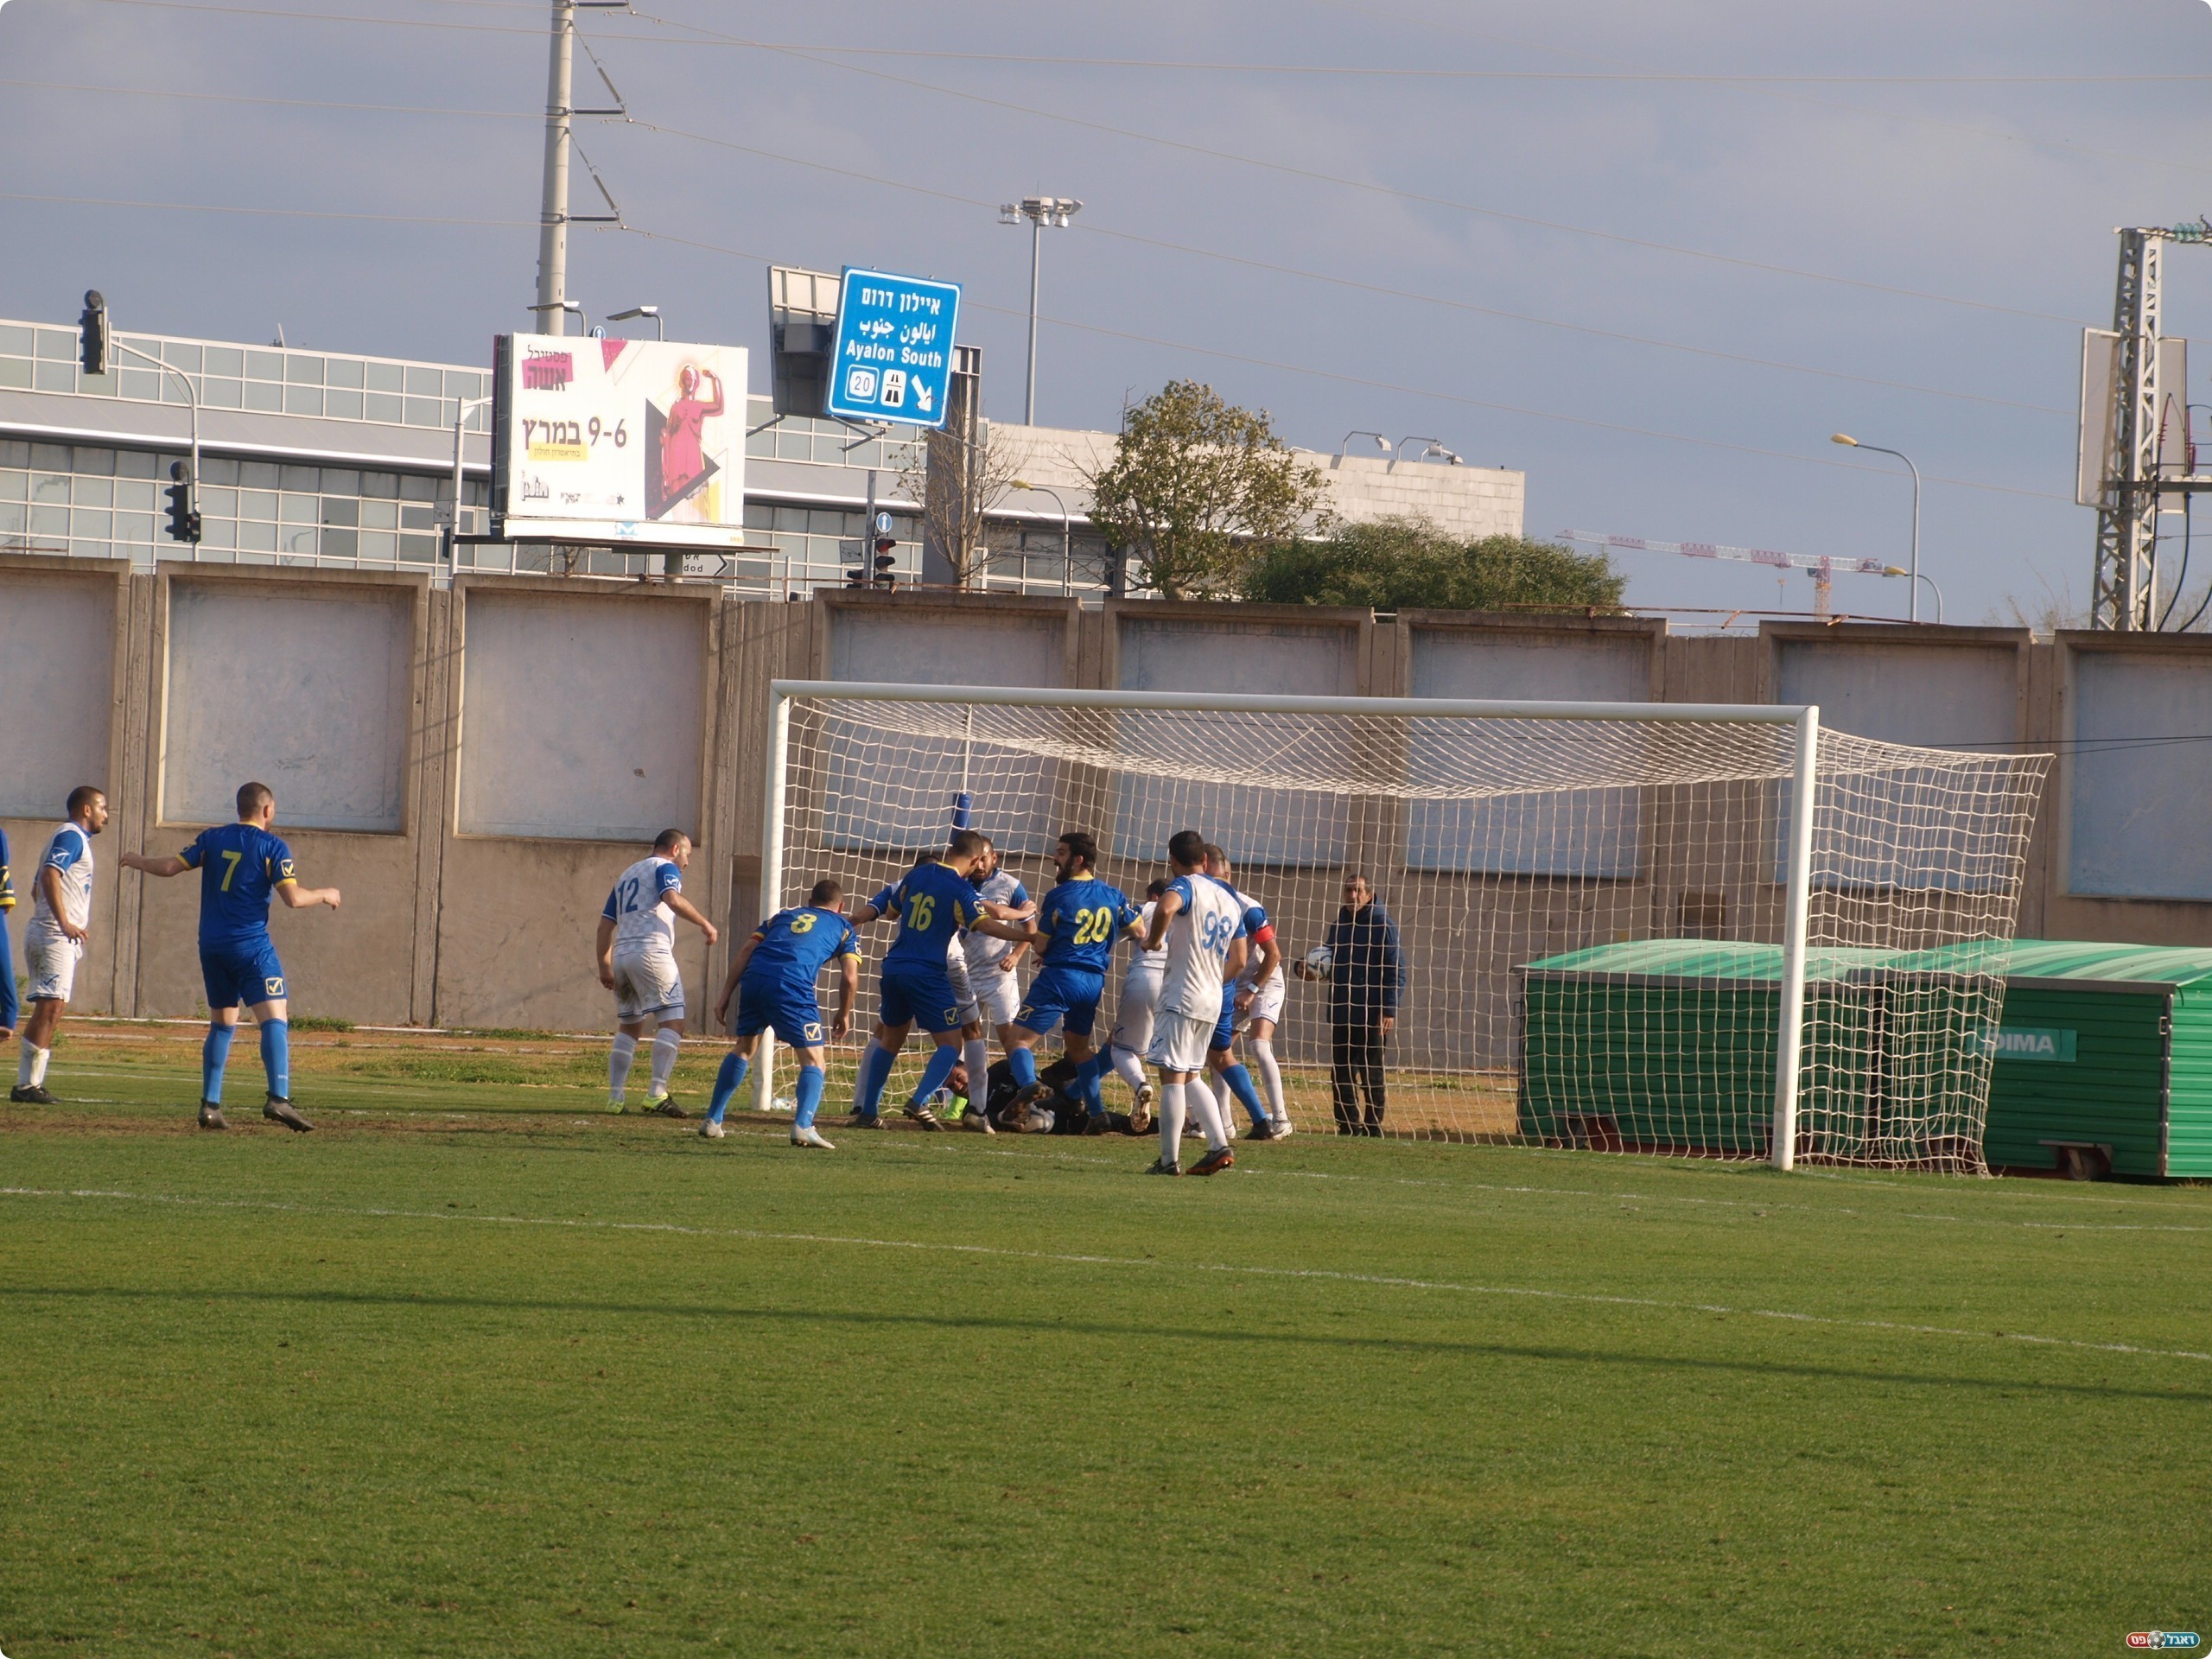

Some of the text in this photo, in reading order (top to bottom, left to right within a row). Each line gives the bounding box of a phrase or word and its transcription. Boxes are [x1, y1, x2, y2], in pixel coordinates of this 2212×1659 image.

[861, 288, 941, 315] איילון דרום
[859, 317, 895, 340] جنوب
[527, 344, 568, 363] פסטיבל
[846, 339, 942, 368] Ayalon South
[527, 365, 566, 391] אשה
[854, 375, 870, 392] 20
[522, 418, 582, 450] במרץ
[683, 563, 703, 572] dod
[220, 849, 243, 892] 7
[618, 877, 639, 915] 12
[908, 892, 936, 931] 16
[1073, 906, 1113, 944] 20
